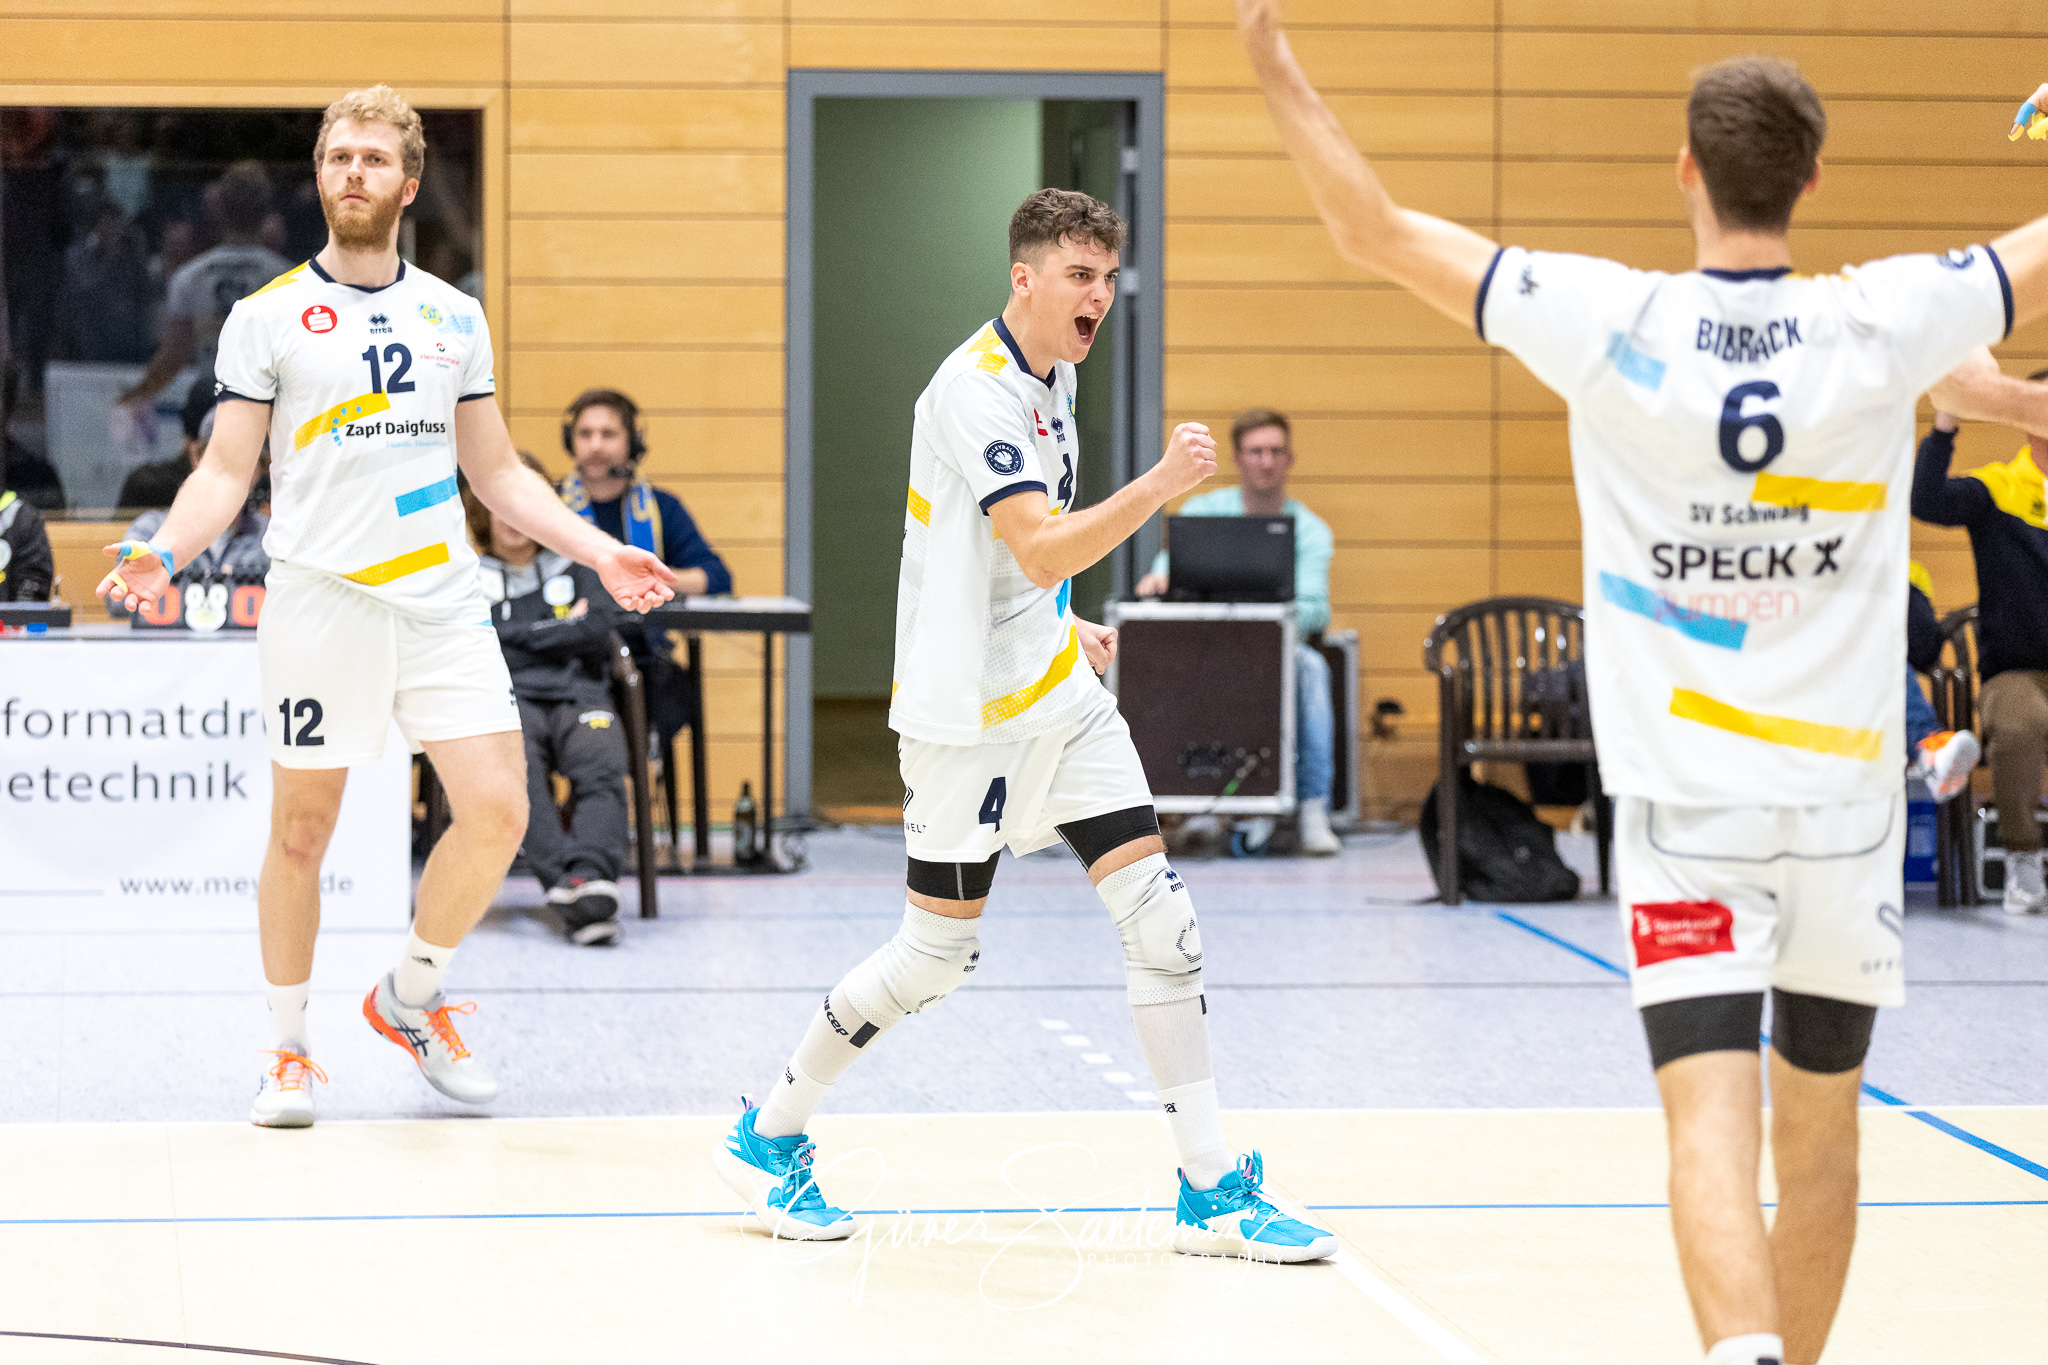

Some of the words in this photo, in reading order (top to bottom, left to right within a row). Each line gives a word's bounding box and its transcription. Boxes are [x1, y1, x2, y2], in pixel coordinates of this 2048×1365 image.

[369, 326, 393, 335] errea
[1697, 314, 1803, 364] BIBRACK
[362, 343, 416, 394] 12
[345, 421, 382, 439] Zapf
[385, 419, 446, 437] Daigfuss
[1718, 379, 1785, 474] 6
[1689, 502, 1714, 524] SV
[1651, 543, 1797, 580] SPECK
[279, 697, 326, 747] 12
[0, 760, 248, 802] etechnik
[977, 776, 1007, 834] 4
